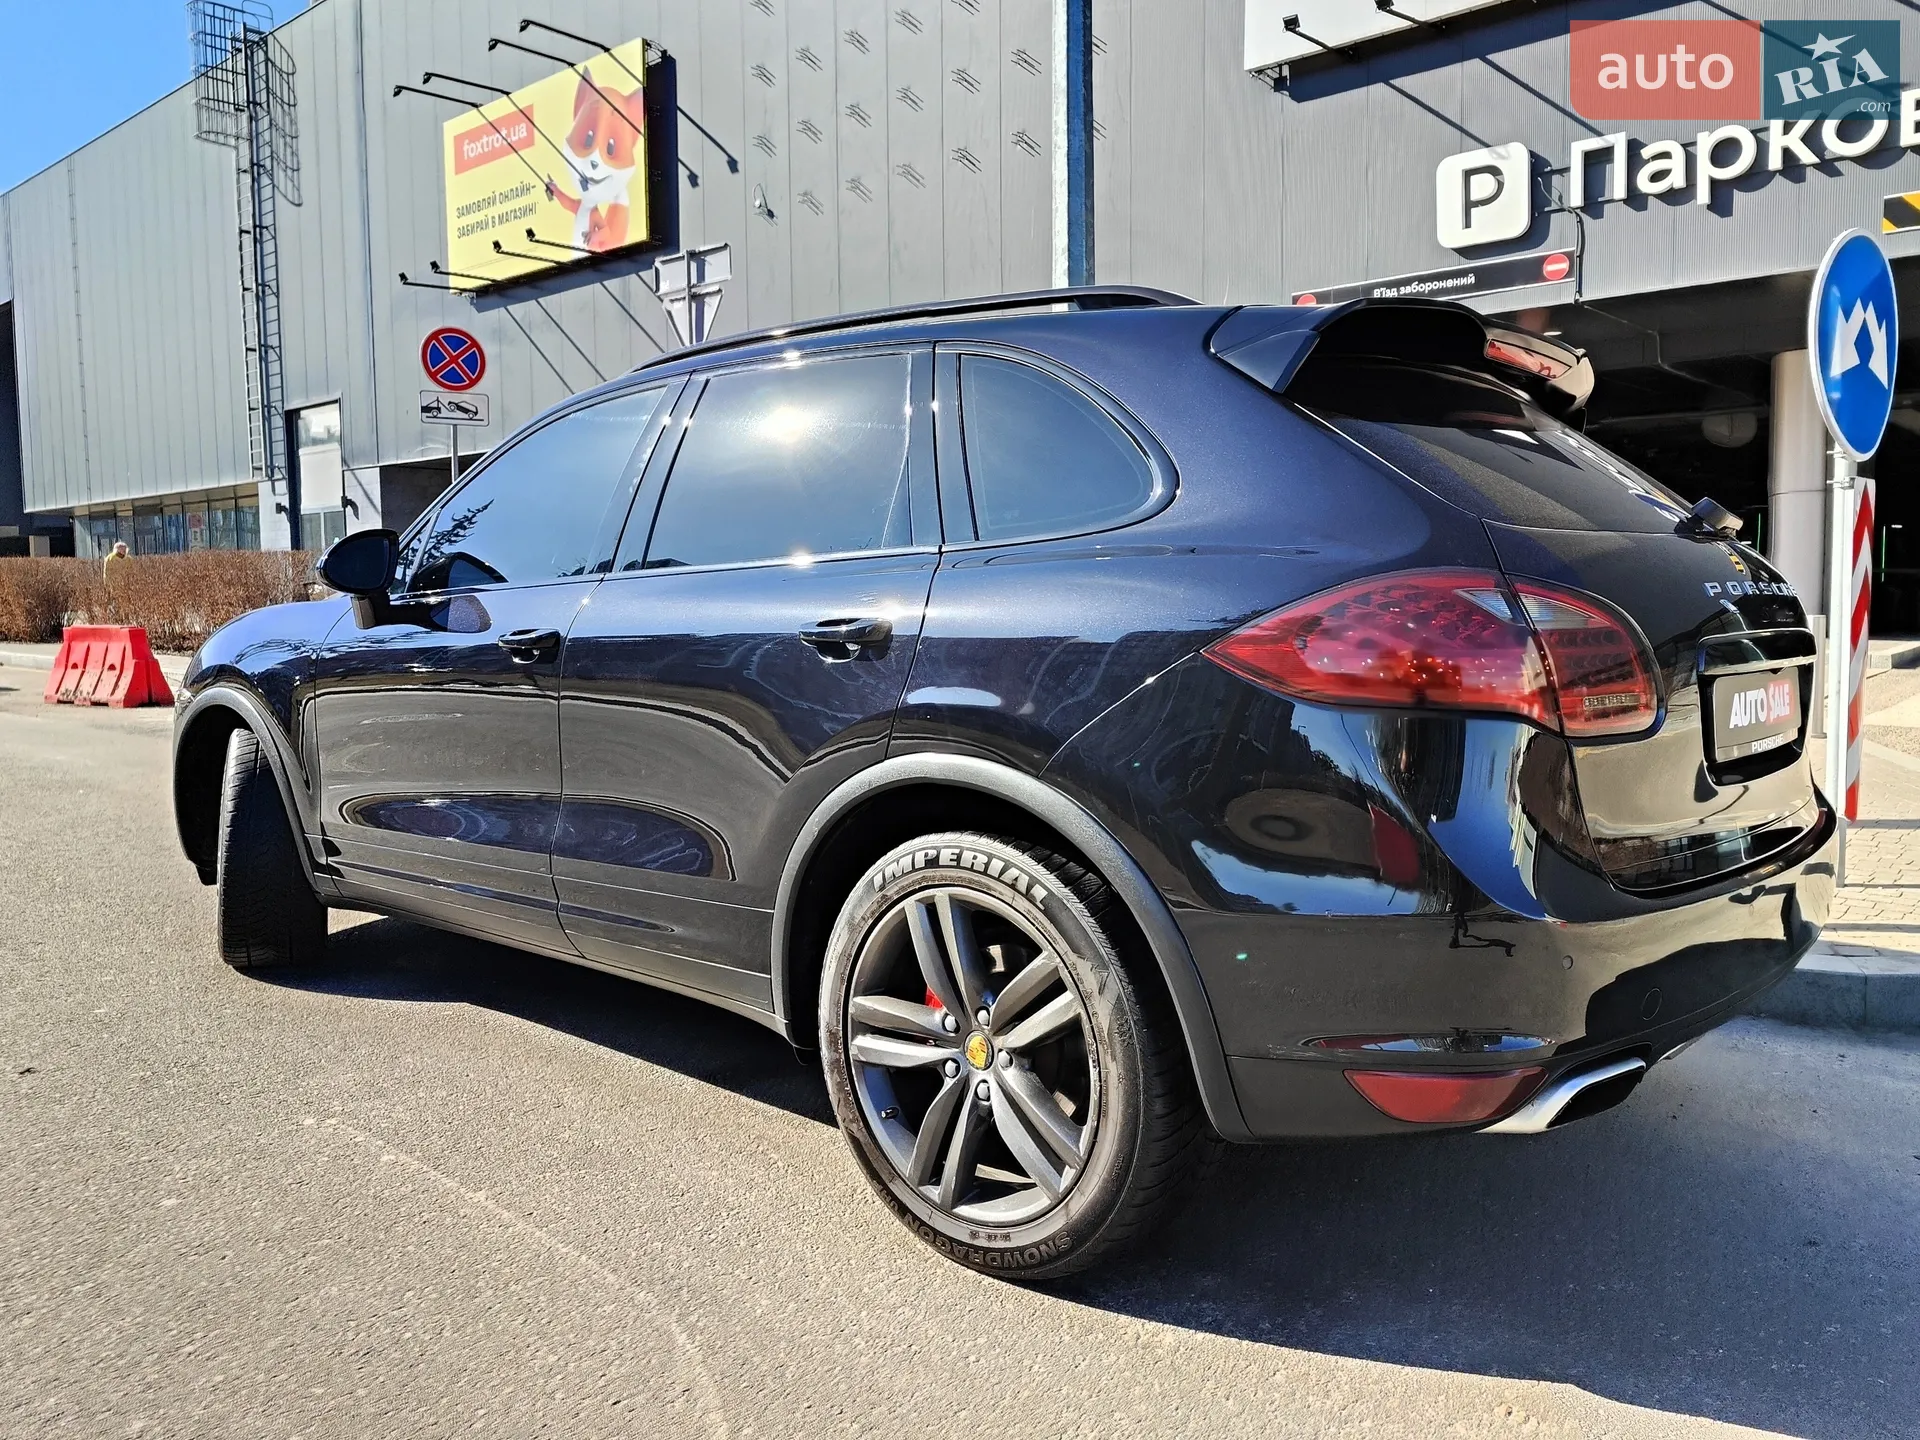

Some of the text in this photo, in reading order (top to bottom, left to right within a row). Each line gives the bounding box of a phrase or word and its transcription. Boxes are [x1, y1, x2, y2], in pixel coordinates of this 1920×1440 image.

[463, 122, 528, 160] foxtrot.ua
[456, 190, 497, 219] ЗАМОВЛЯЙ
[456, 203, 537, 239] ЗАБИРАЙ В МАГАЗИНІ
[1399, 273, 1476, 294] заборонений
[1729, 688, 1767, 729] AUTO
[1751, 734, 1784, 753] PORSCHE
[873, 848, 1049, 910] IMPERIAL
